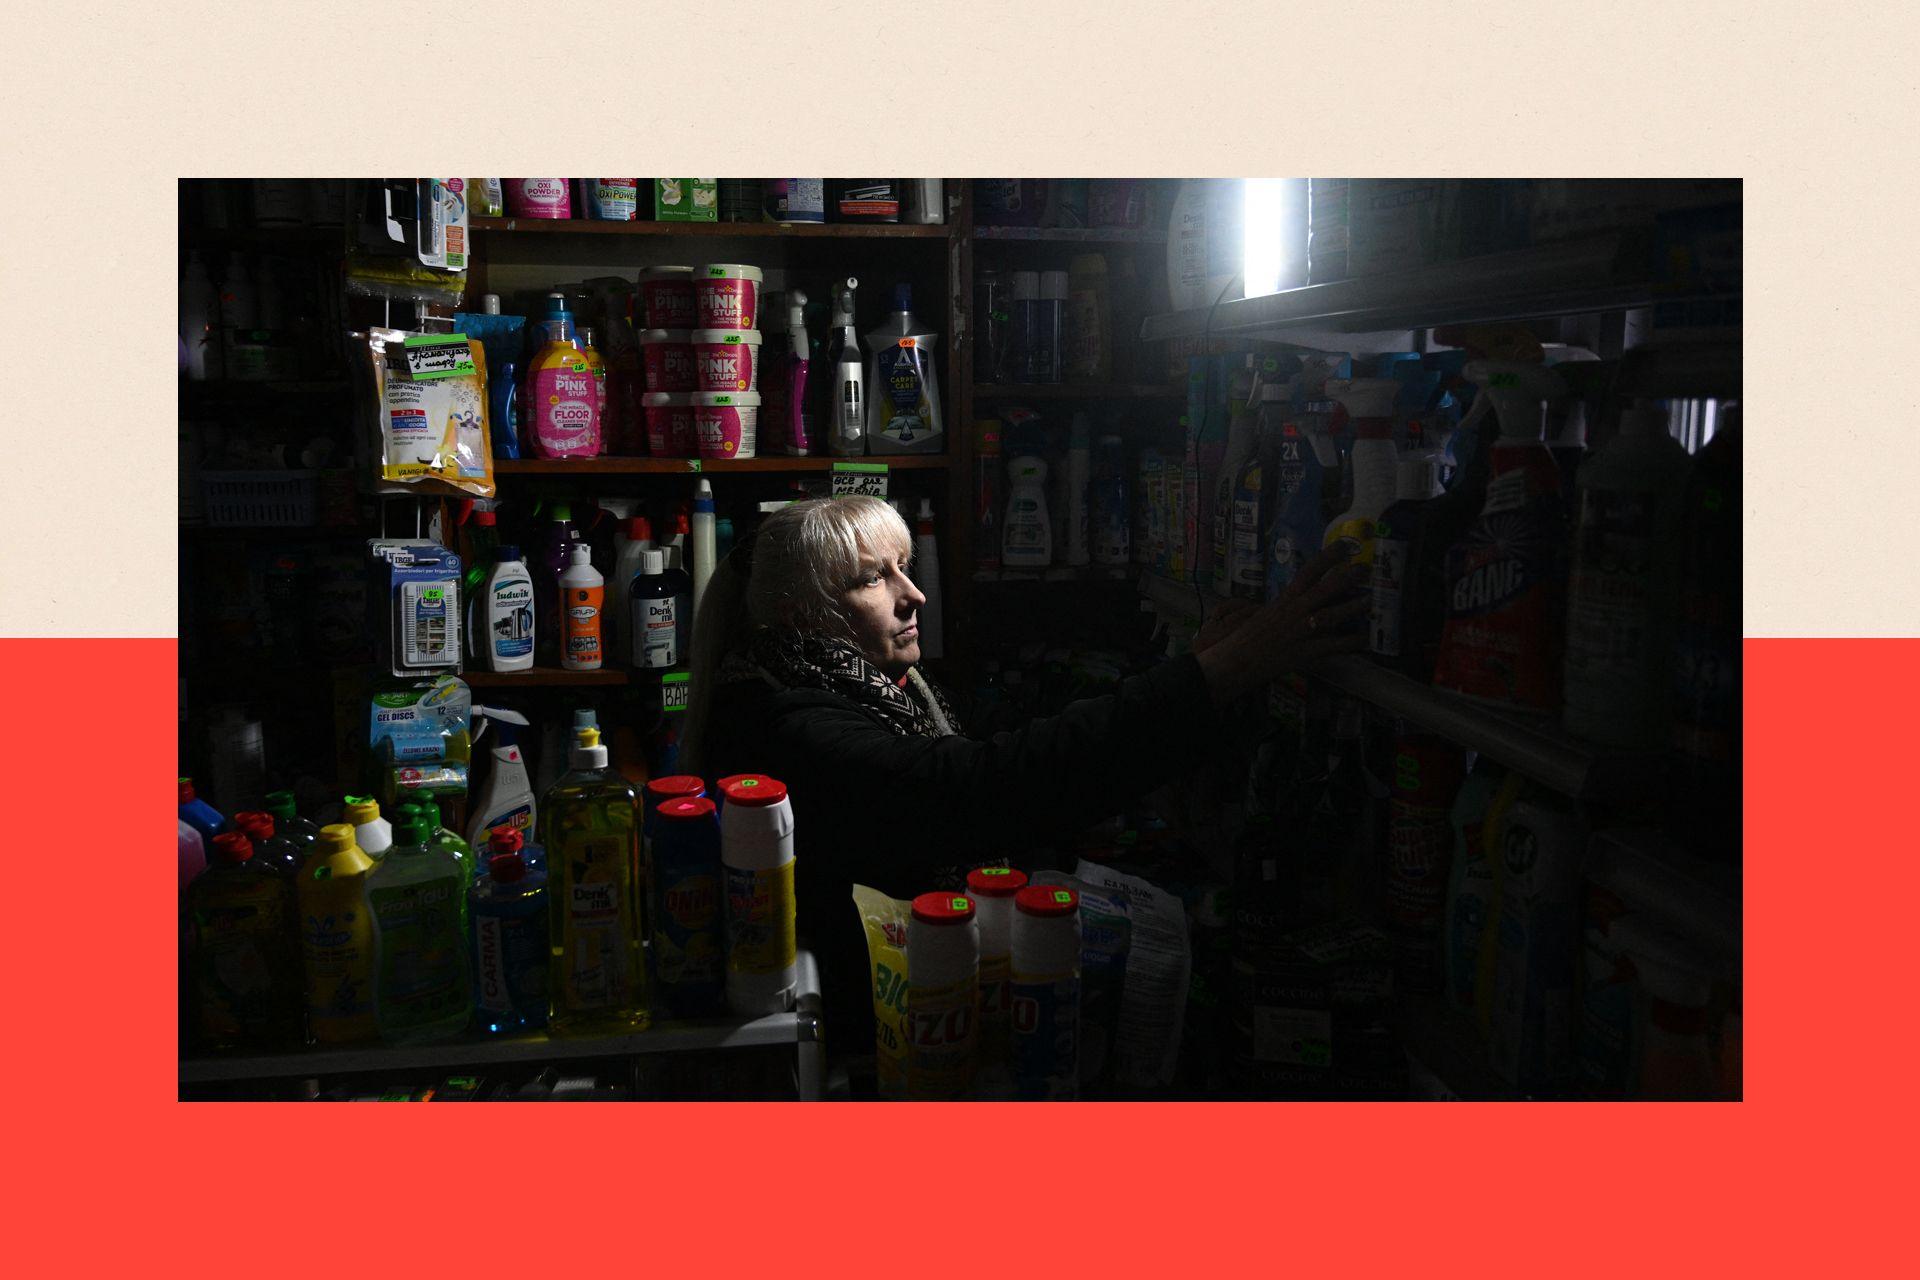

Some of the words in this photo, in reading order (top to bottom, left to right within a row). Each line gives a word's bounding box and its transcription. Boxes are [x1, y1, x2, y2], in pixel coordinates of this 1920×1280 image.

[700, 294, 743, 309] PINK
[713, 309, 743, 317] STUFF
[697, 358, 738, 373] PINK
[709, 373, 738, 381] STUFF
[387, 384, 424, 392] PROFUMATO
[555, 380, 587, 391] PINK
[555, 410, 589, 420] FLOOR
[1453, 559, 1524, 611] BANG
[650, 606, 672, 616] Denk
[438, 706, 446, 715] 12
[377, 713, 390, 722] GEL
[391, 711, 415, 721] DISCS
